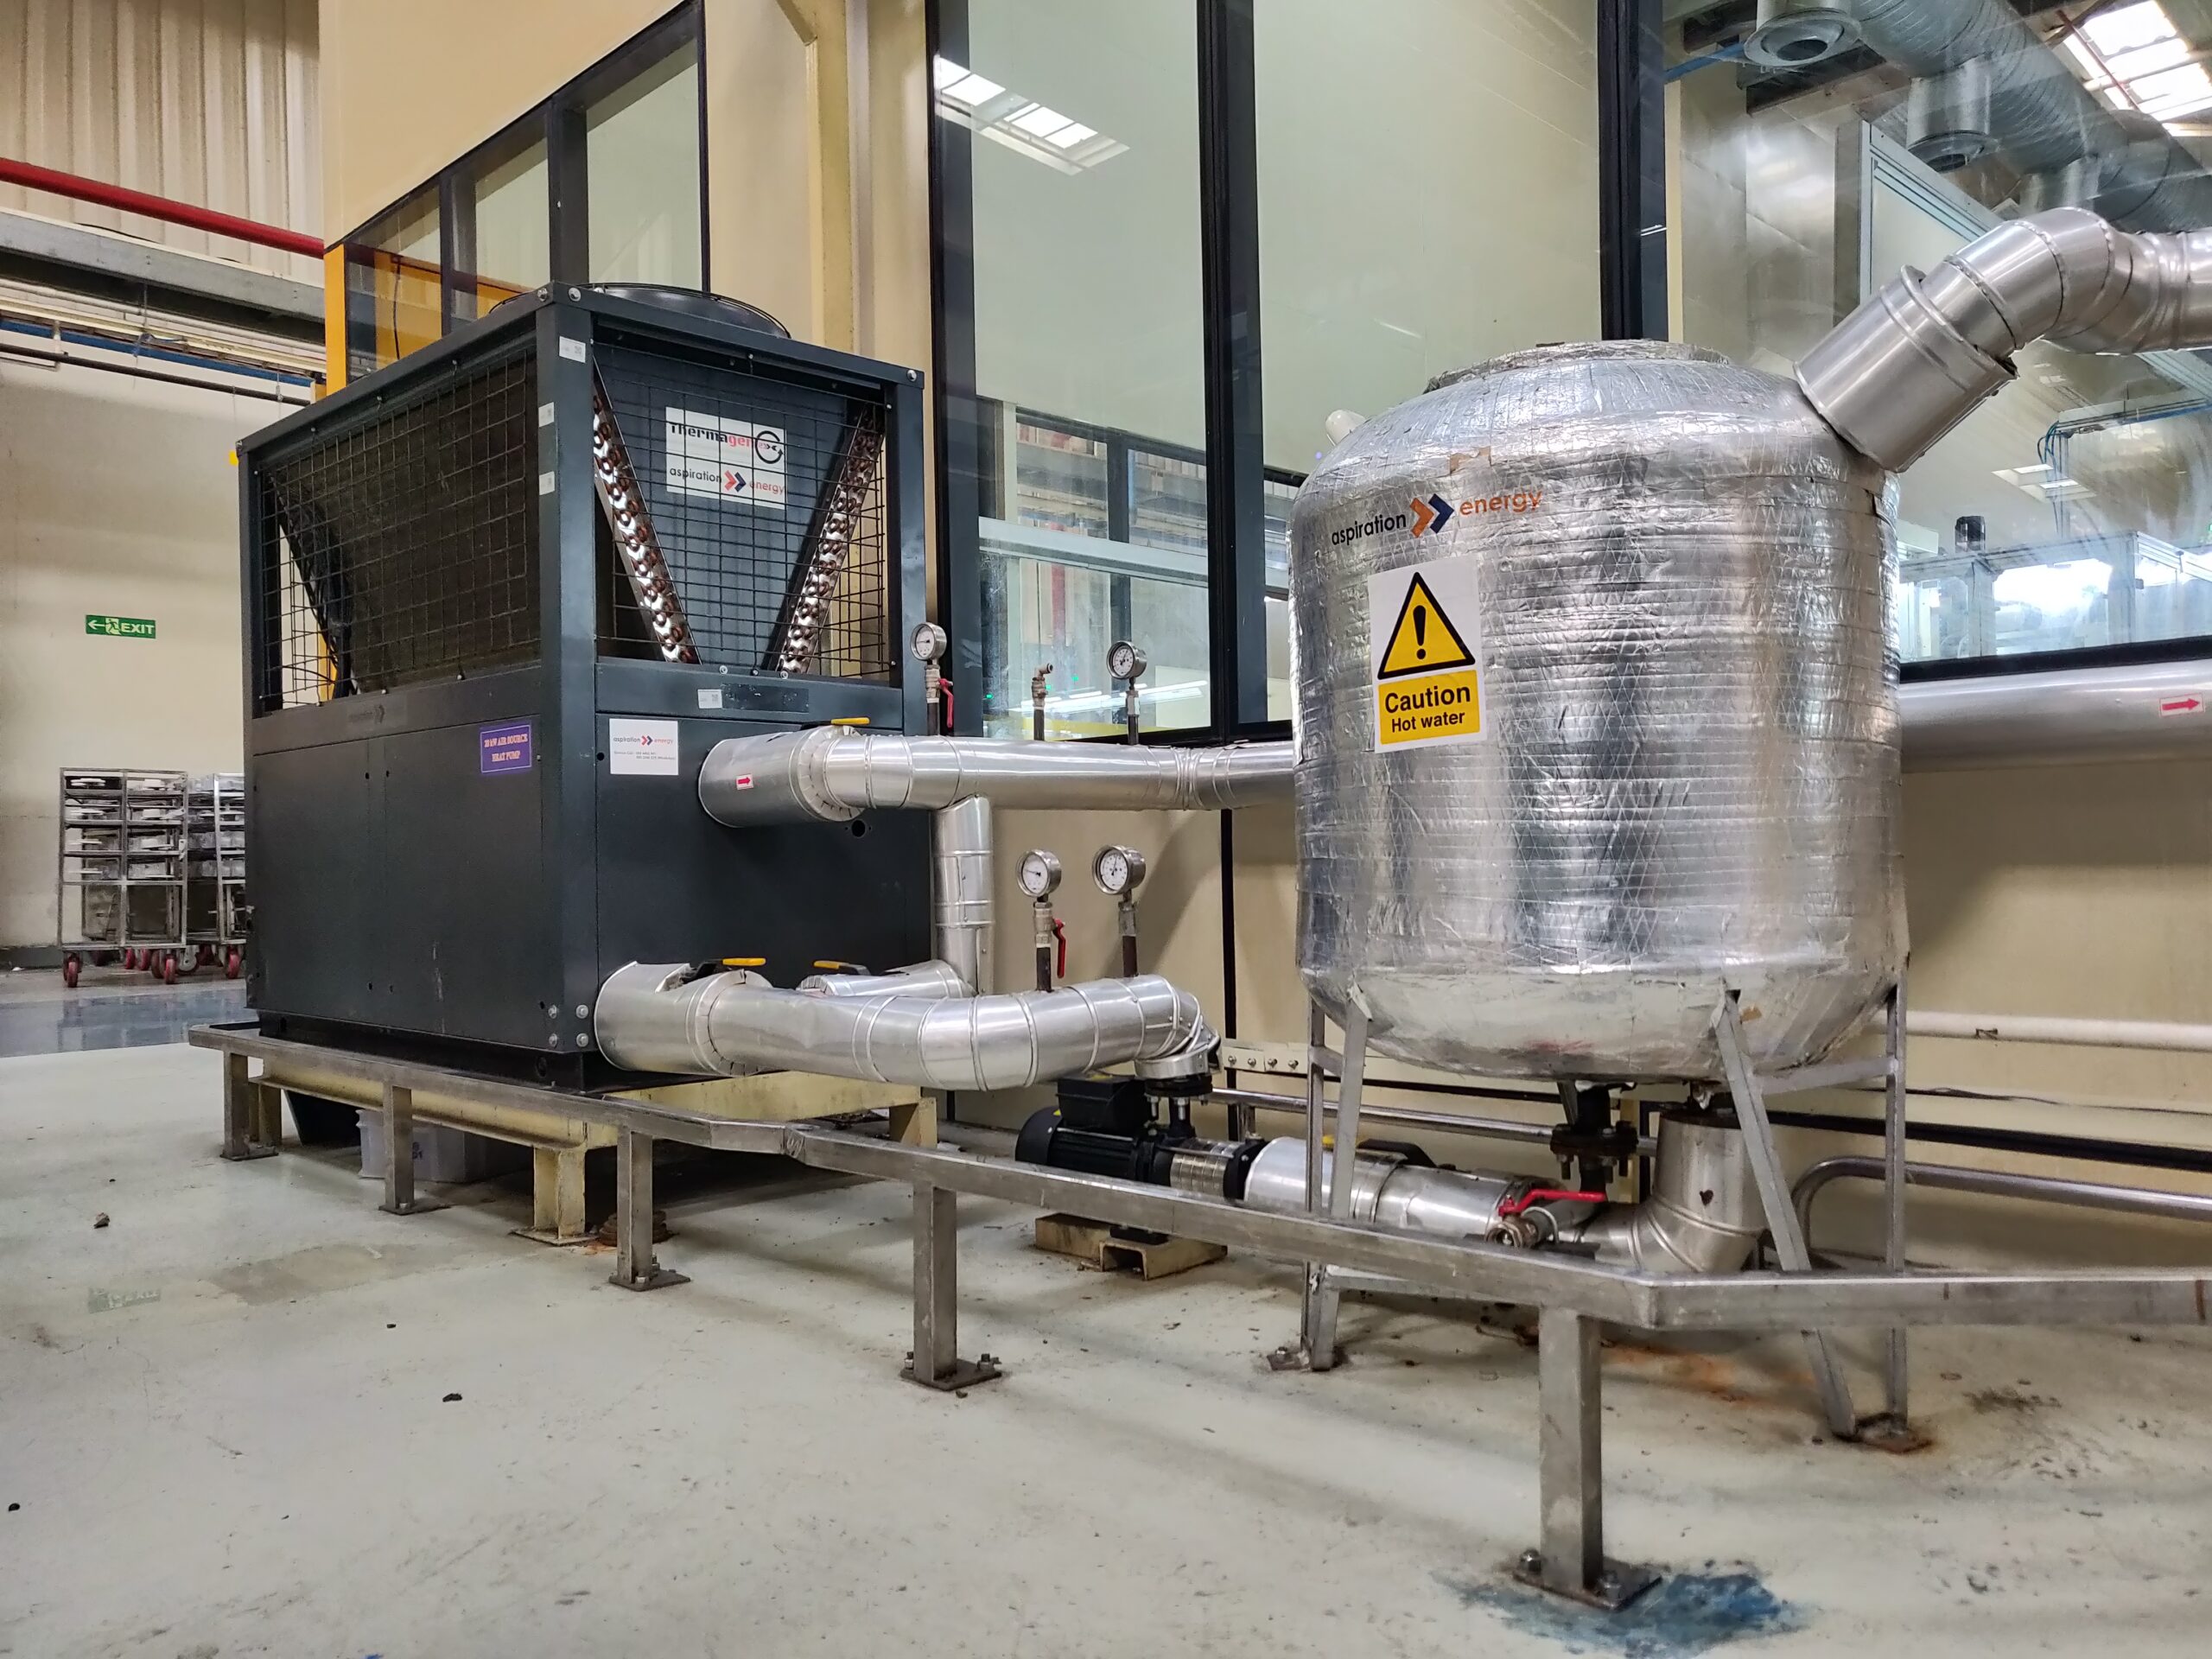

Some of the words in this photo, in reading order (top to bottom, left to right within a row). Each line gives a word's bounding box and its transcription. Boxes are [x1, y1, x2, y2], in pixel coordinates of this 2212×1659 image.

[670, 467, 721, 483] aspiration
[749, 480, 784, 494] energy
[1332, 513, 1407, 546] aspiration
[1459, 491, 1542, 517] energy
[121, 623, 155, 634] EXIT
[1384, 685, 1471, 714] Caution
[1391, 715, 1416, 734] Hot
[1421, 709, 1465, 728] water
[507, 734, 528, 744] SOURCE
[505, 750, 521, 760] PUMP
